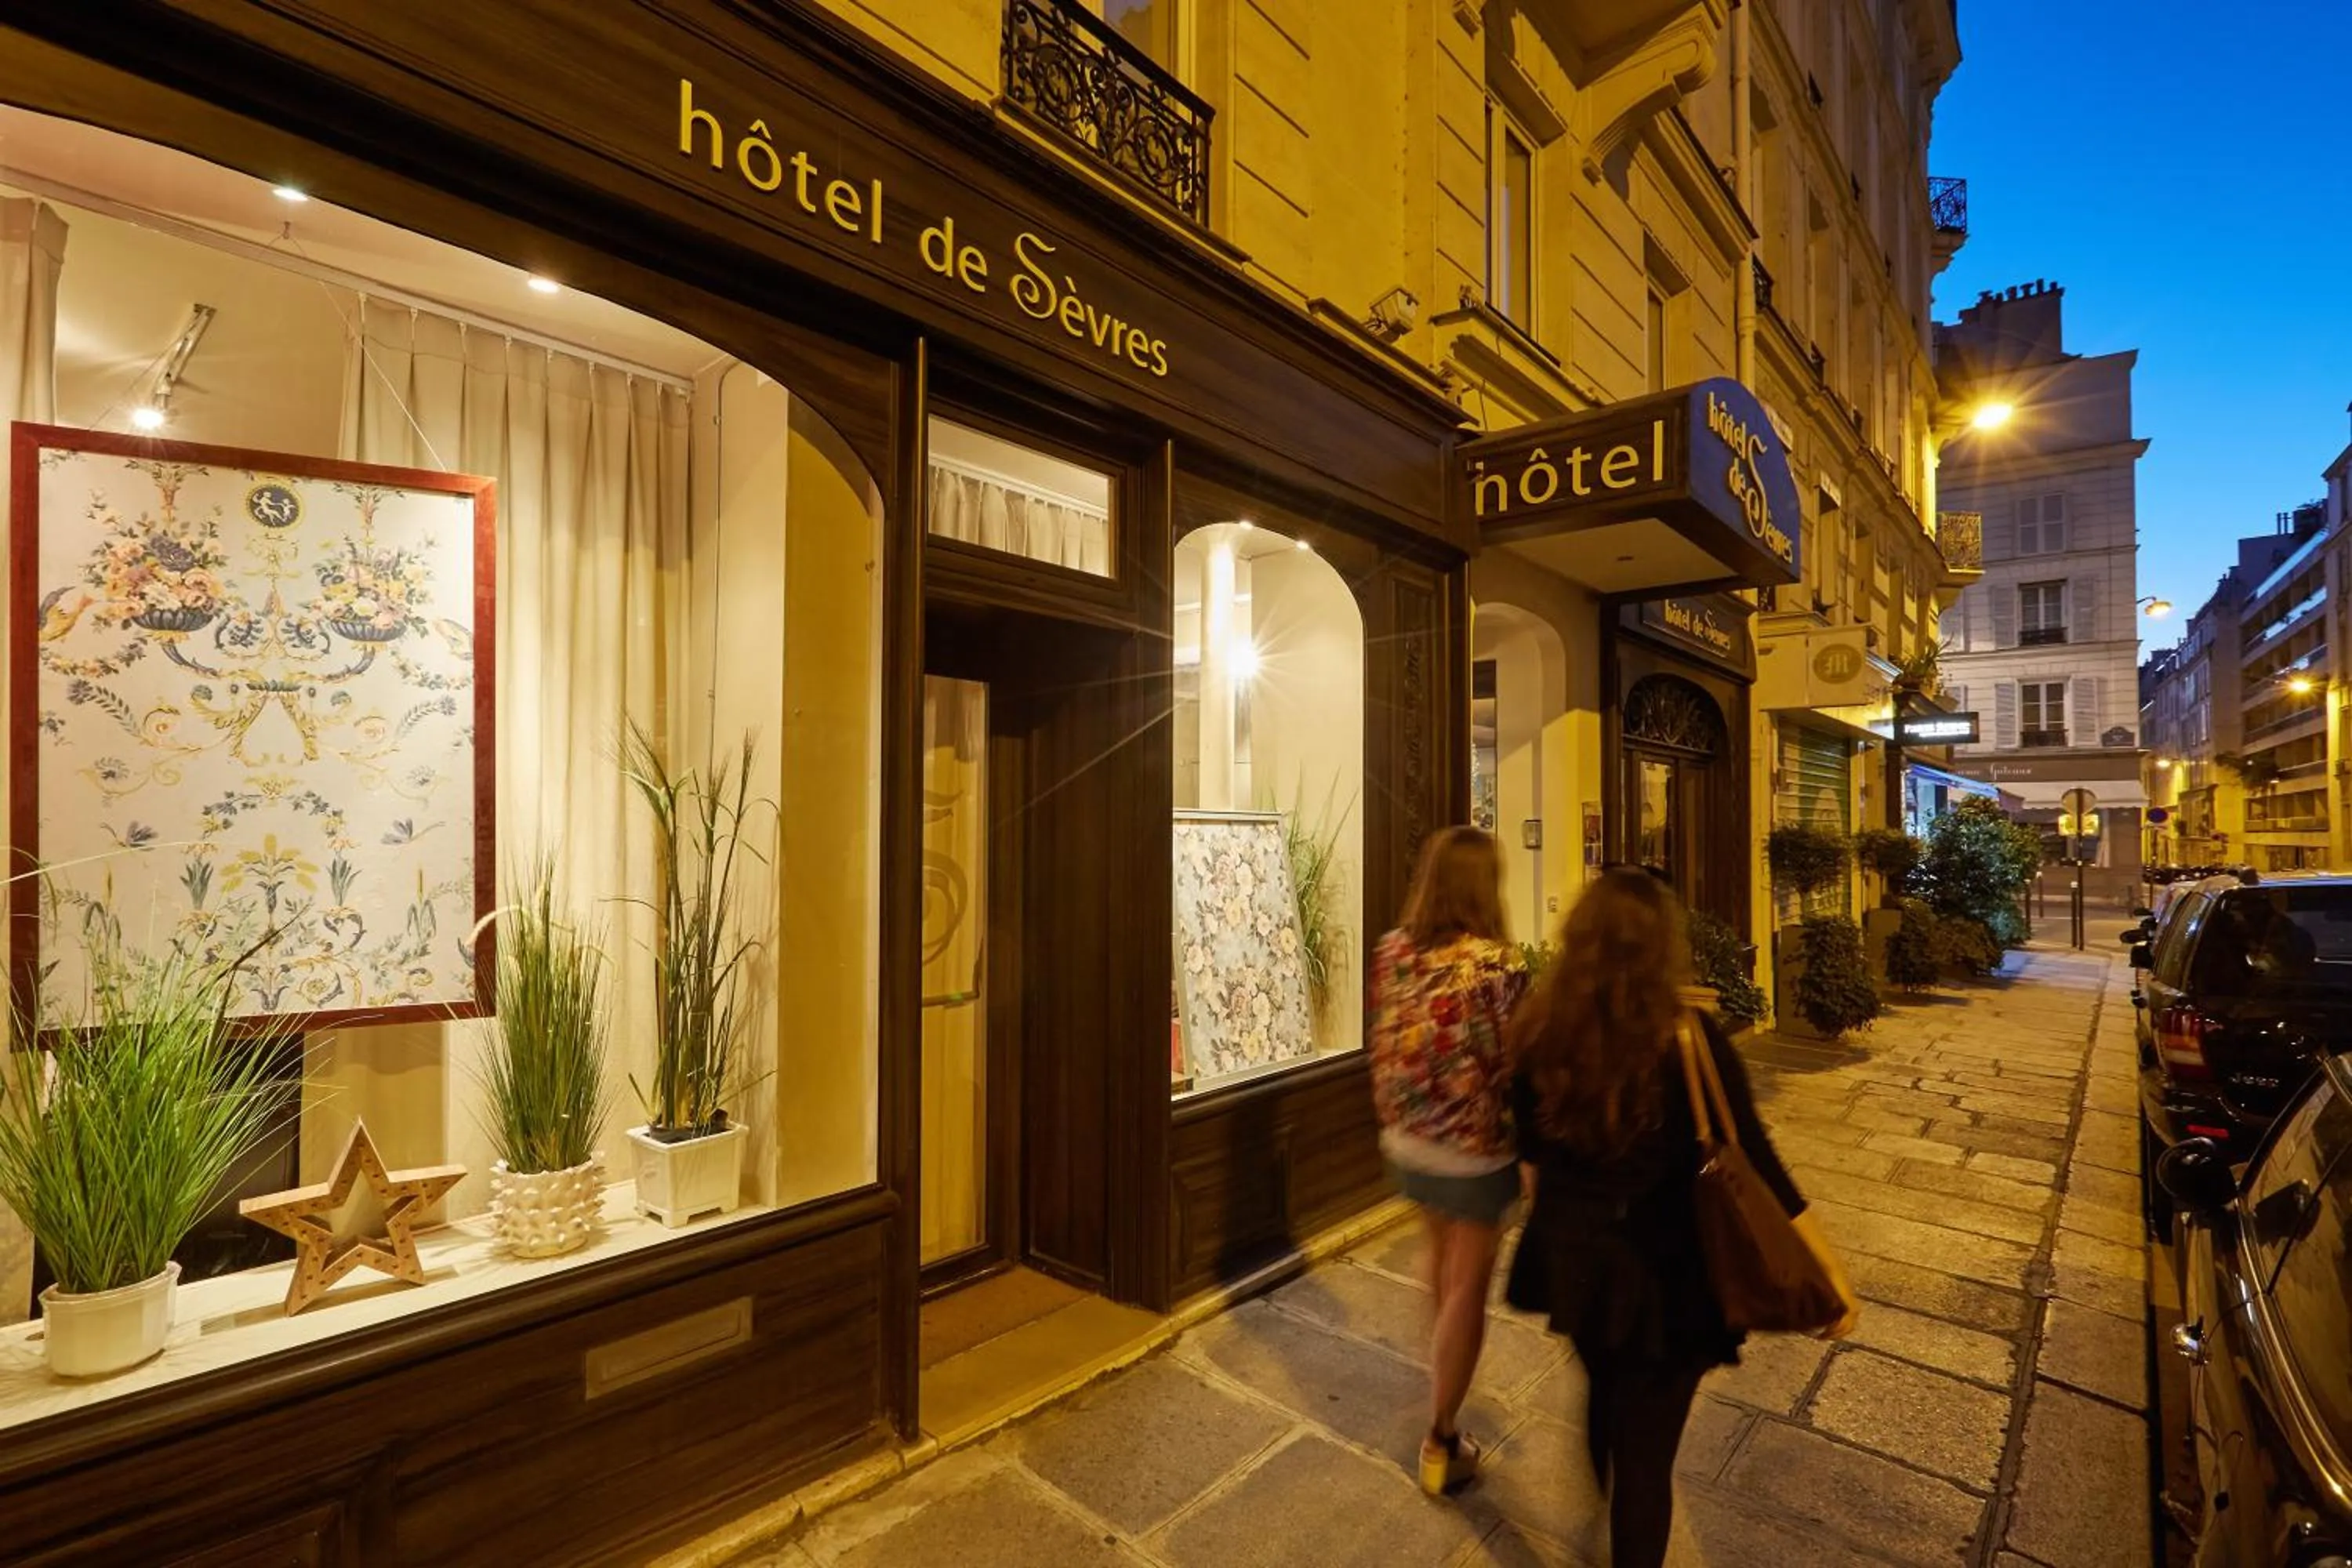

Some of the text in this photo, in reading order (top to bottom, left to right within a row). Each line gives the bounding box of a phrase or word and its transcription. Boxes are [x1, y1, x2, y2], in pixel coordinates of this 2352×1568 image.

[679, 78, 1168, 377] hôtel de Sèvres
[1708, 391, 1748, 460] hôtel
[1475, 419, 1664, 516] hôtel
[1728, 457, 1747, 502] de
[1664, 598, 1690, 632] hôtel
[1693, 614, 1704, 639] de
[2229, 1071, 2281, 1088] Jeep
